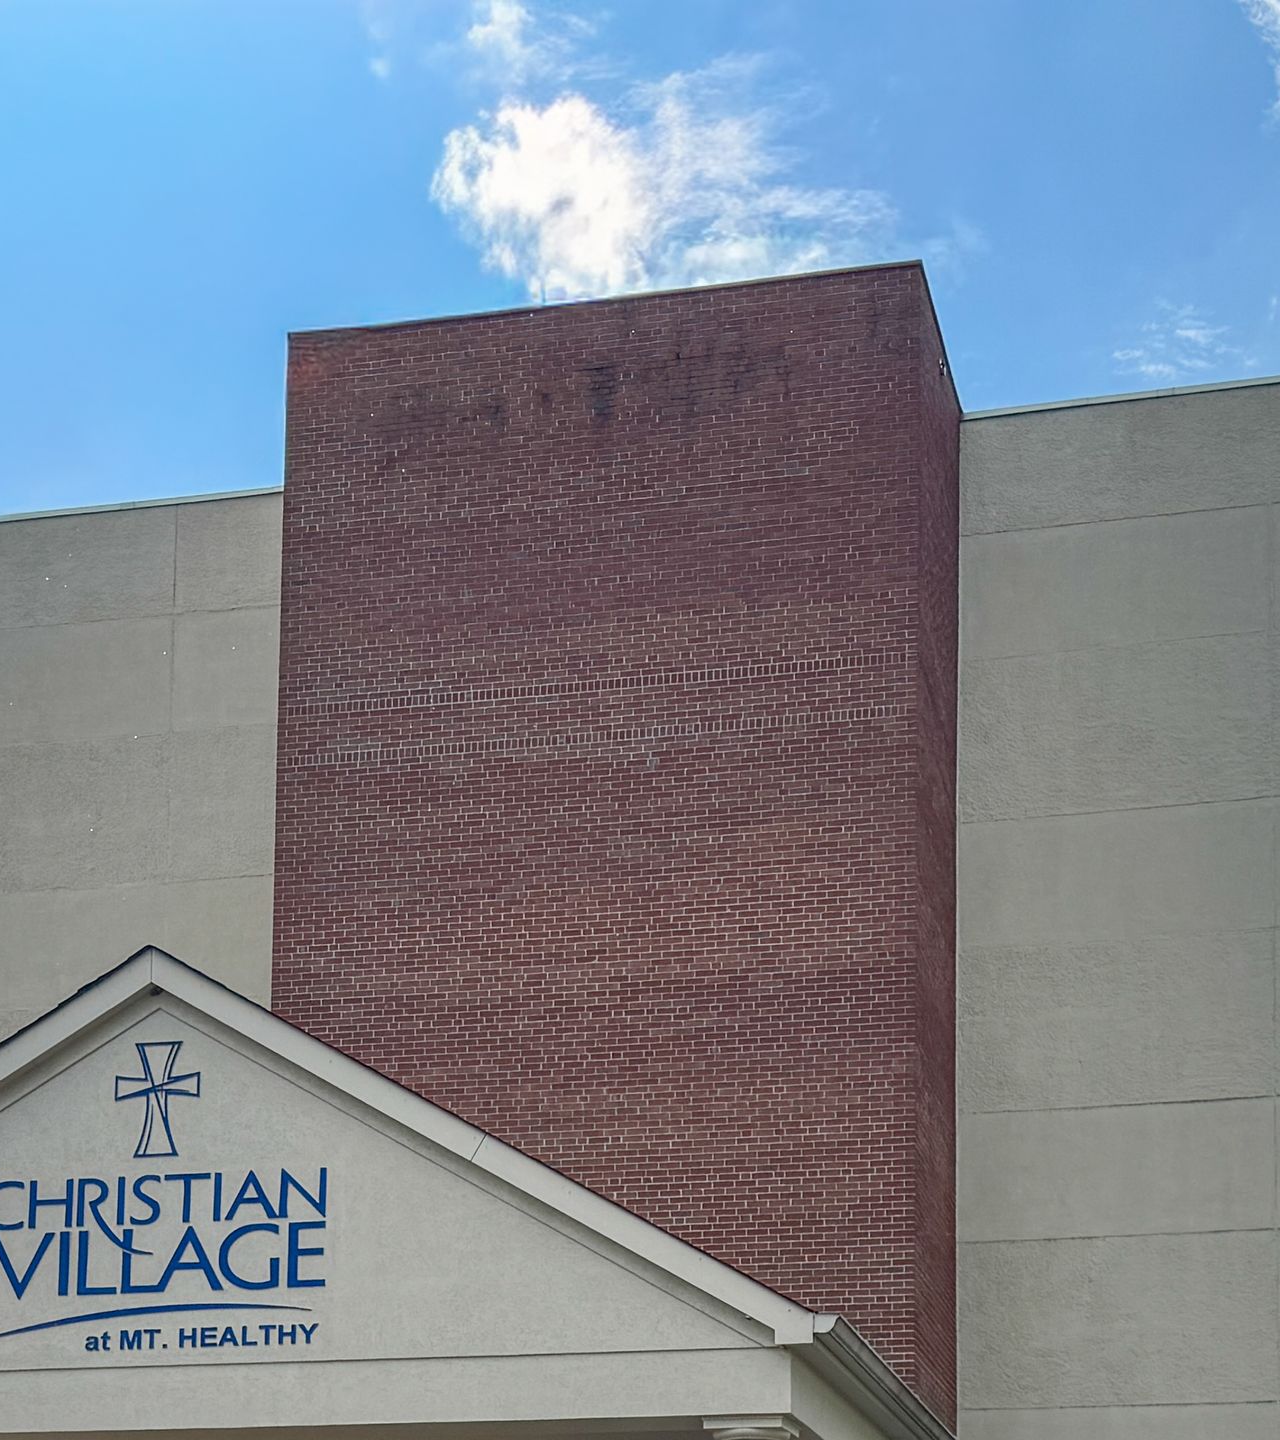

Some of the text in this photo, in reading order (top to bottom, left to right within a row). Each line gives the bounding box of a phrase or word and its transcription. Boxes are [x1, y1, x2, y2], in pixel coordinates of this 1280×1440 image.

[84, 1323, 319, 1352] at MT. HEALTHY
